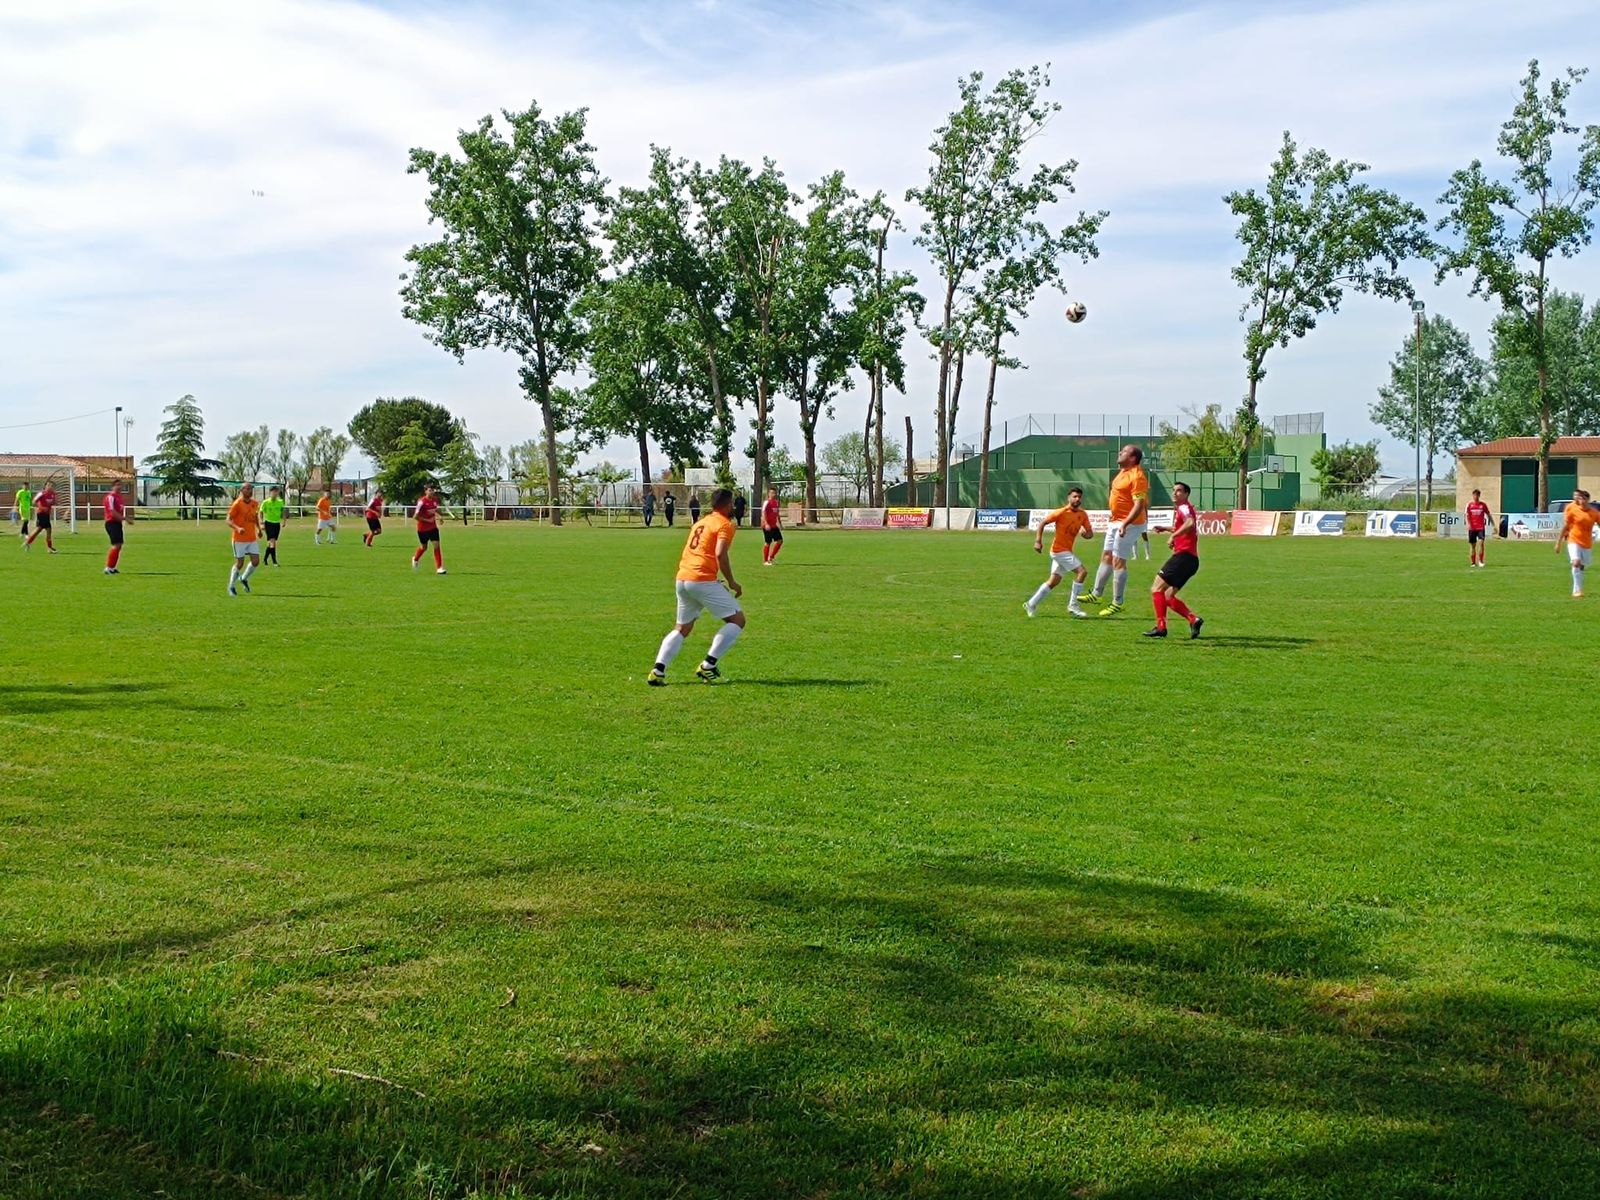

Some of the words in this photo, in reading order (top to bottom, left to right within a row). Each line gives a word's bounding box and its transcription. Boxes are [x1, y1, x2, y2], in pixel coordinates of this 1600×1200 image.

[1439, 512, 1459, 525] Bar
[1196, 519, 1227, 536] RGOS
[689, 525, 705, 550] 8
